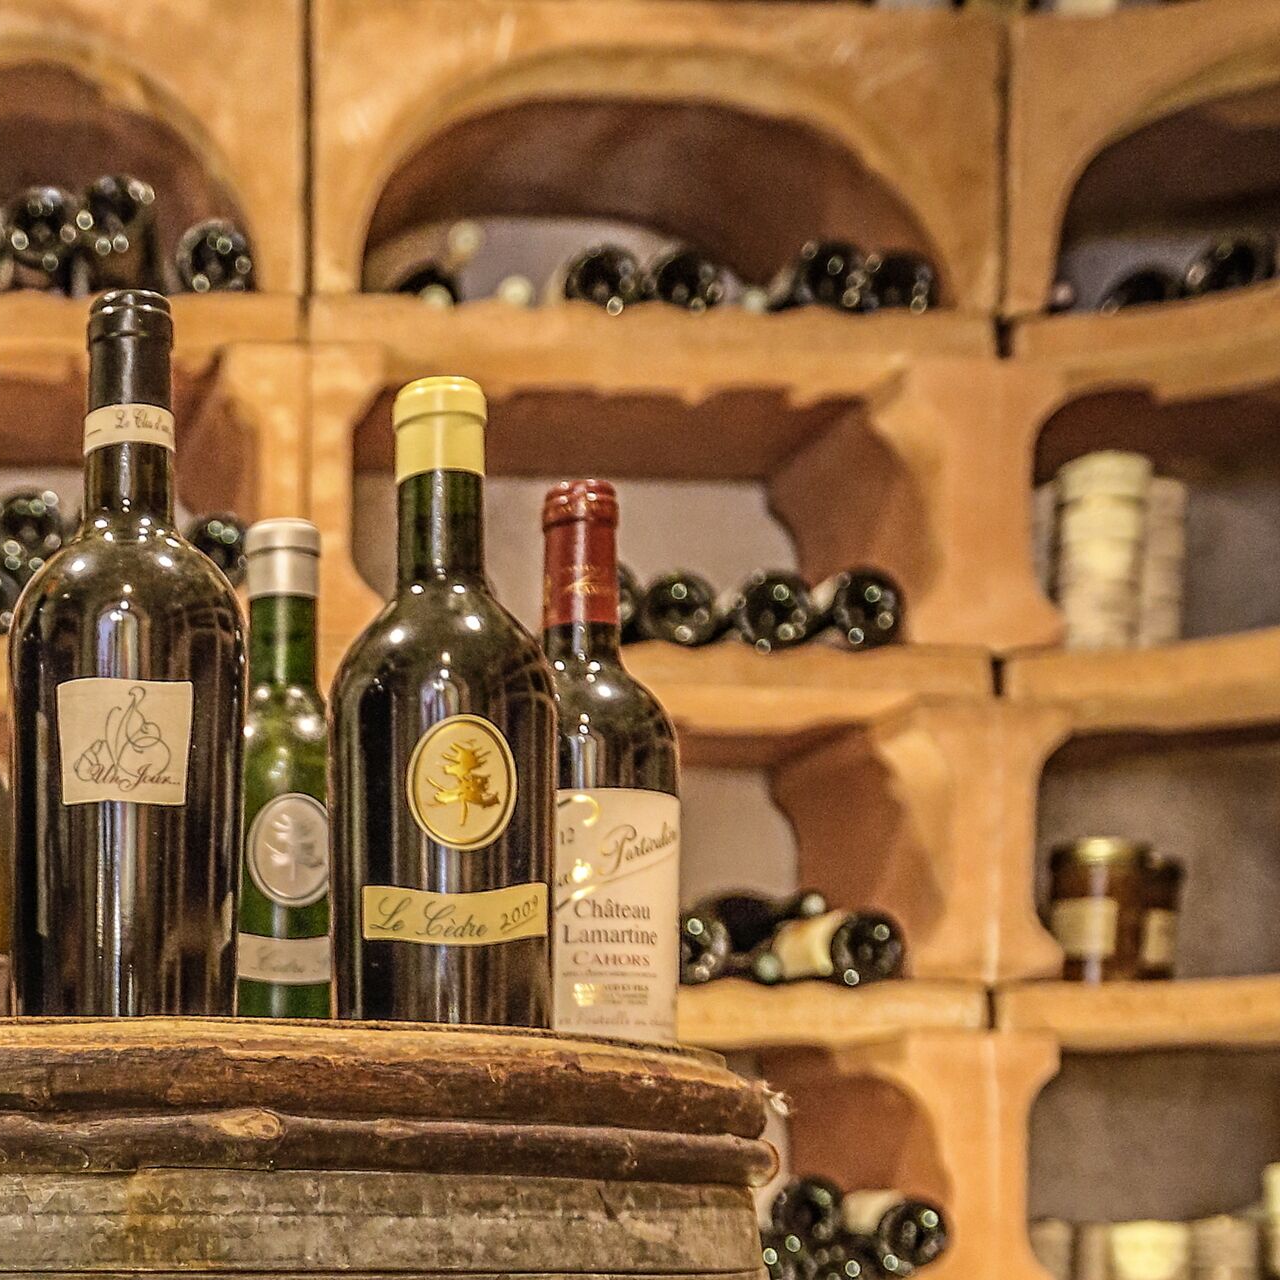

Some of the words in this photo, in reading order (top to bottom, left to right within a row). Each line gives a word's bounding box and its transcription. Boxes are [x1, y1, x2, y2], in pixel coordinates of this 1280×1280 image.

[370, 896, 412, 932] Le
[573, 898, 651, 920] Château
[562, 924, 658, 946] Lamartine
